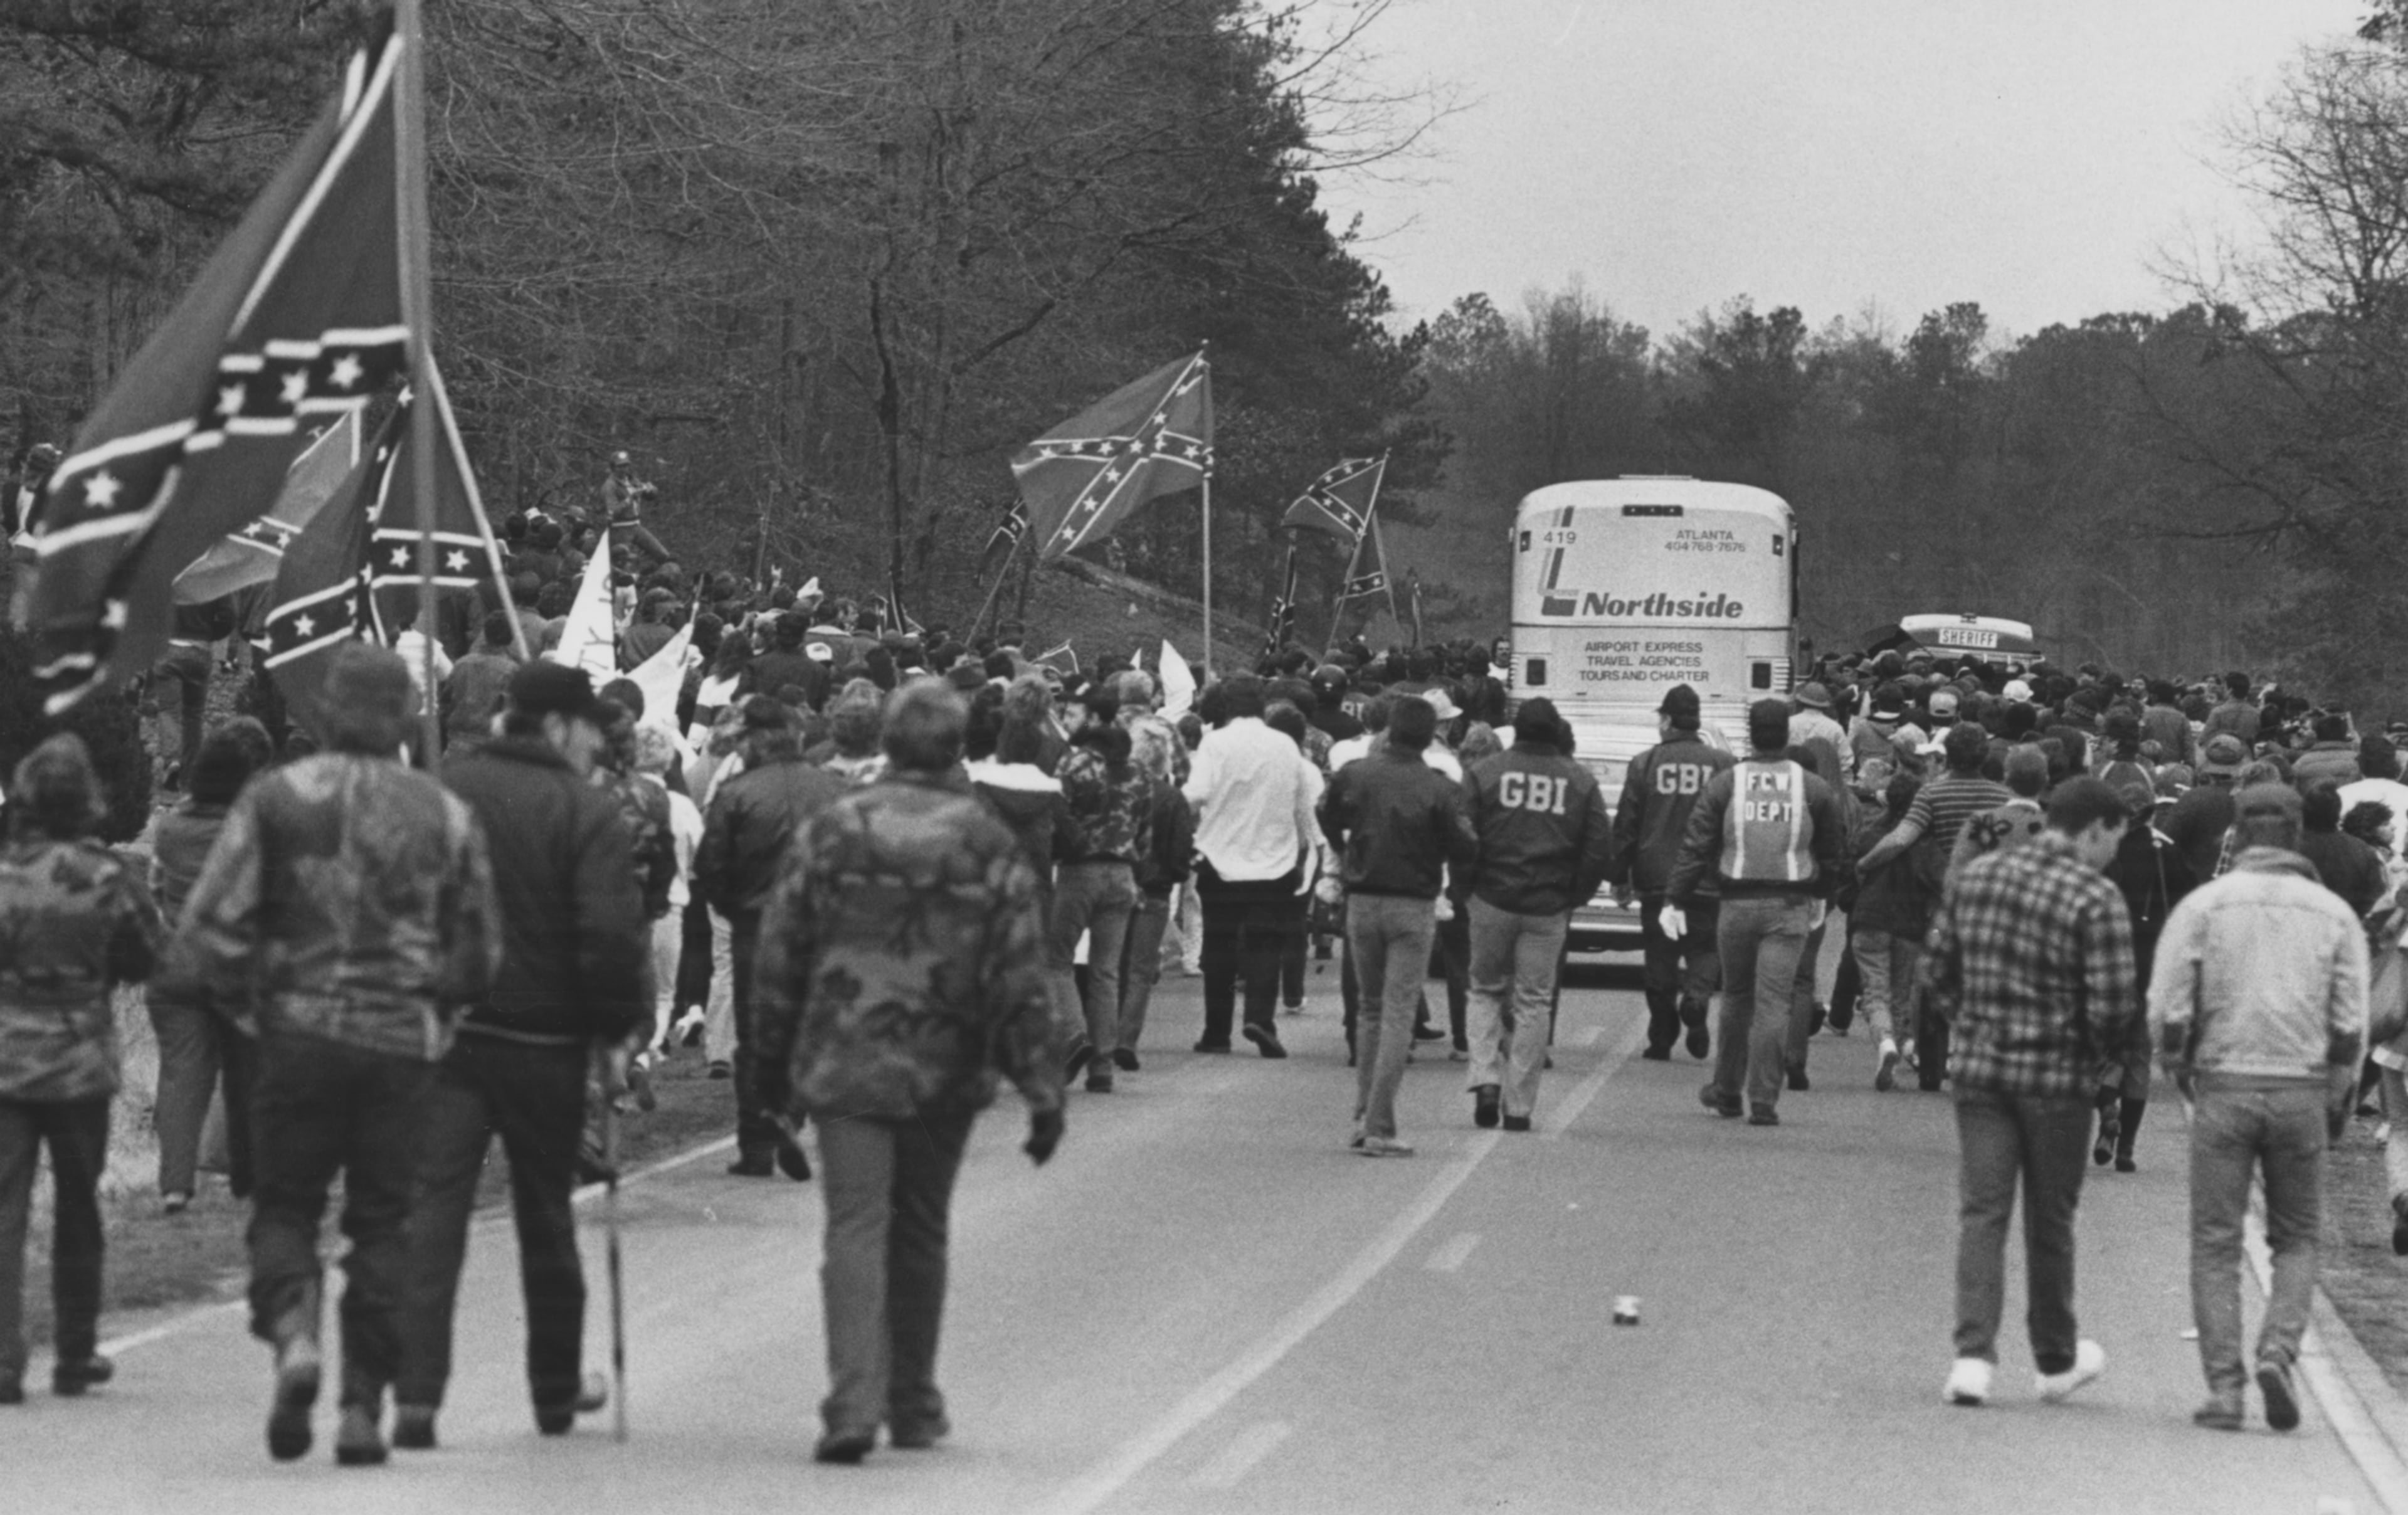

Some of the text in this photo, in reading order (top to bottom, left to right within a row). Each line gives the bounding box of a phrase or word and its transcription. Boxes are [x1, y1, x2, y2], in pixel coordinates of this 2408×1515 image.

[1543, 531, 1576, 544] 419
[1676, 530, 1733, 540] ATLANTA
[1582, 591, 1743, 618] Northside
[1943, 630, 1993, 645] SHERIFF
[1585, 641, 1703, 653] AIRPORT EXPRESS
[1587, 655, 1701, 667] TRAVEL AGENCIES
[1579, 670, 1709, 682] TOURS AND CHARTER
[1499, 771, 1568, 815] GBI
[1745, 801, 1792, 822] DEPT
